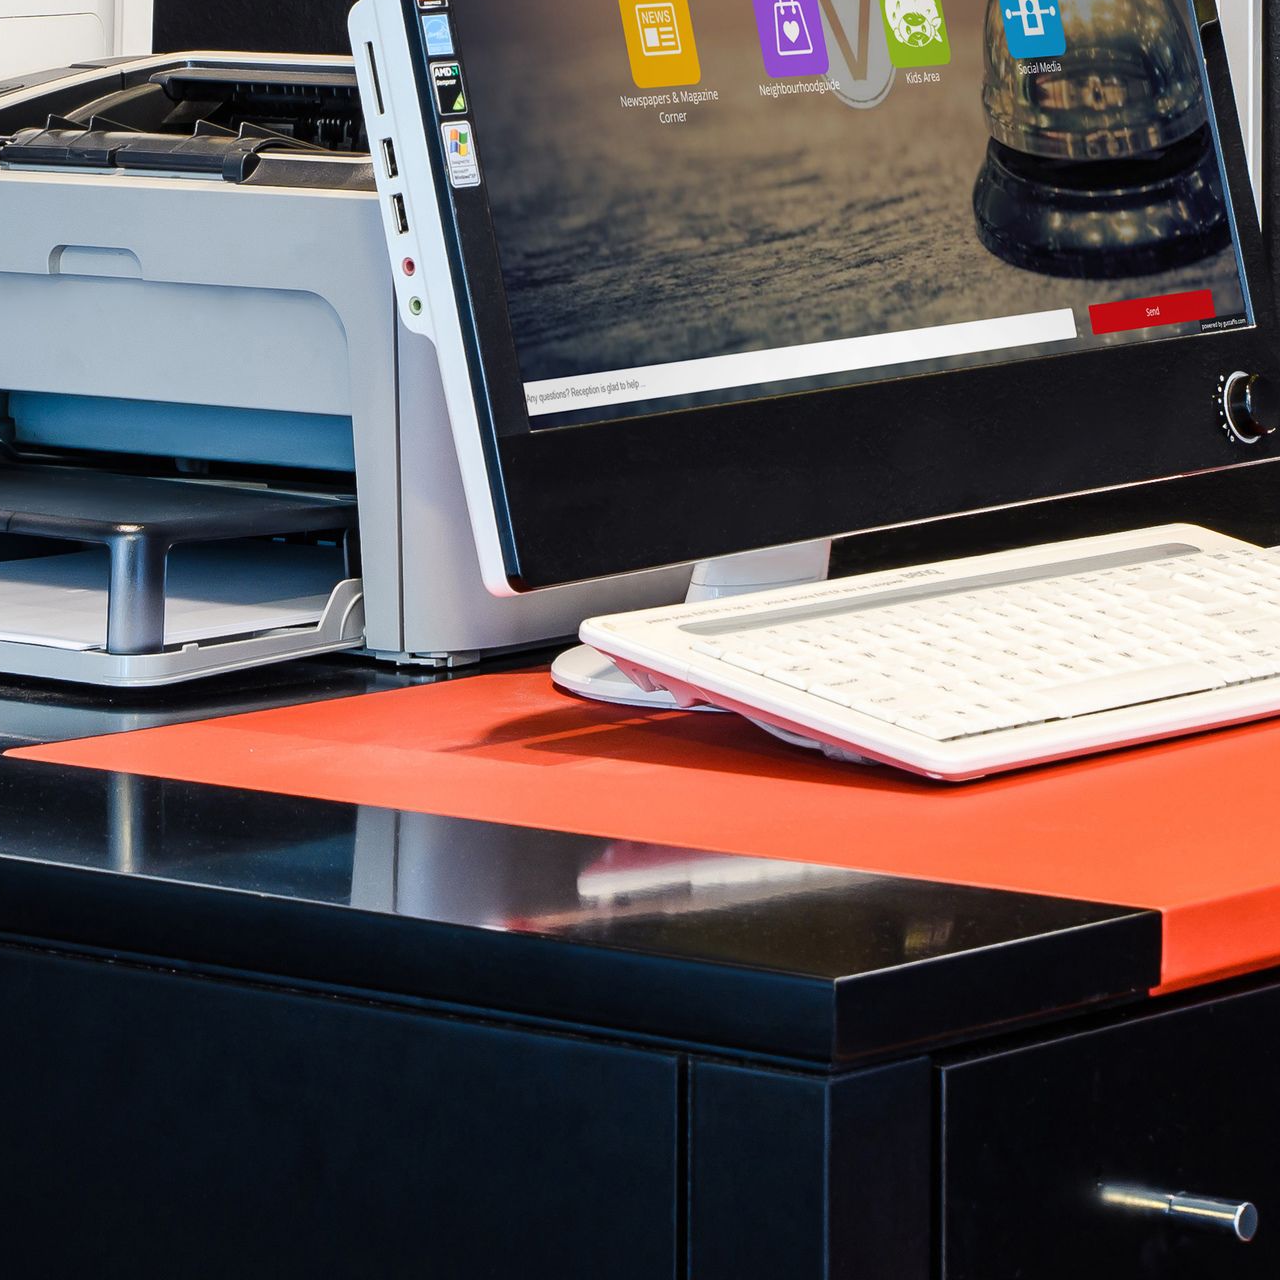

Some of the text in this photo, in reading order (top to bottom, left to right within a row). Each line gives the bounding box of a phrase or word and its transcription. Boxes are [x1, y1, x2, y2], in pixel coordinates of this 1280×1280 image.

[641, 10, 671, 24] NEWS
[434, 67, 452, 77] AMD
[1017, 60, 1062, 75] Social Media
[905, 71, 940, 84] Kids Area
[759, 78, 841, 98] Neighbourhoodguide
[620, 89, 719, 109] Newspapers & Magazine
[659, 111, 687, 124] Corner
[1145, 306, 1160, 317] Send
[1201, 322, 1218, 331] powered
[526, 394, 538, 404] Any
[539, 388, 570, 403] questions?
[571, 385, 600, 398] Reception
[601, 384, 606, 393] is
[607, 381, 619, 395] glad
[620, 381, 626, 390] to
[627, 379, 640, 390] help
